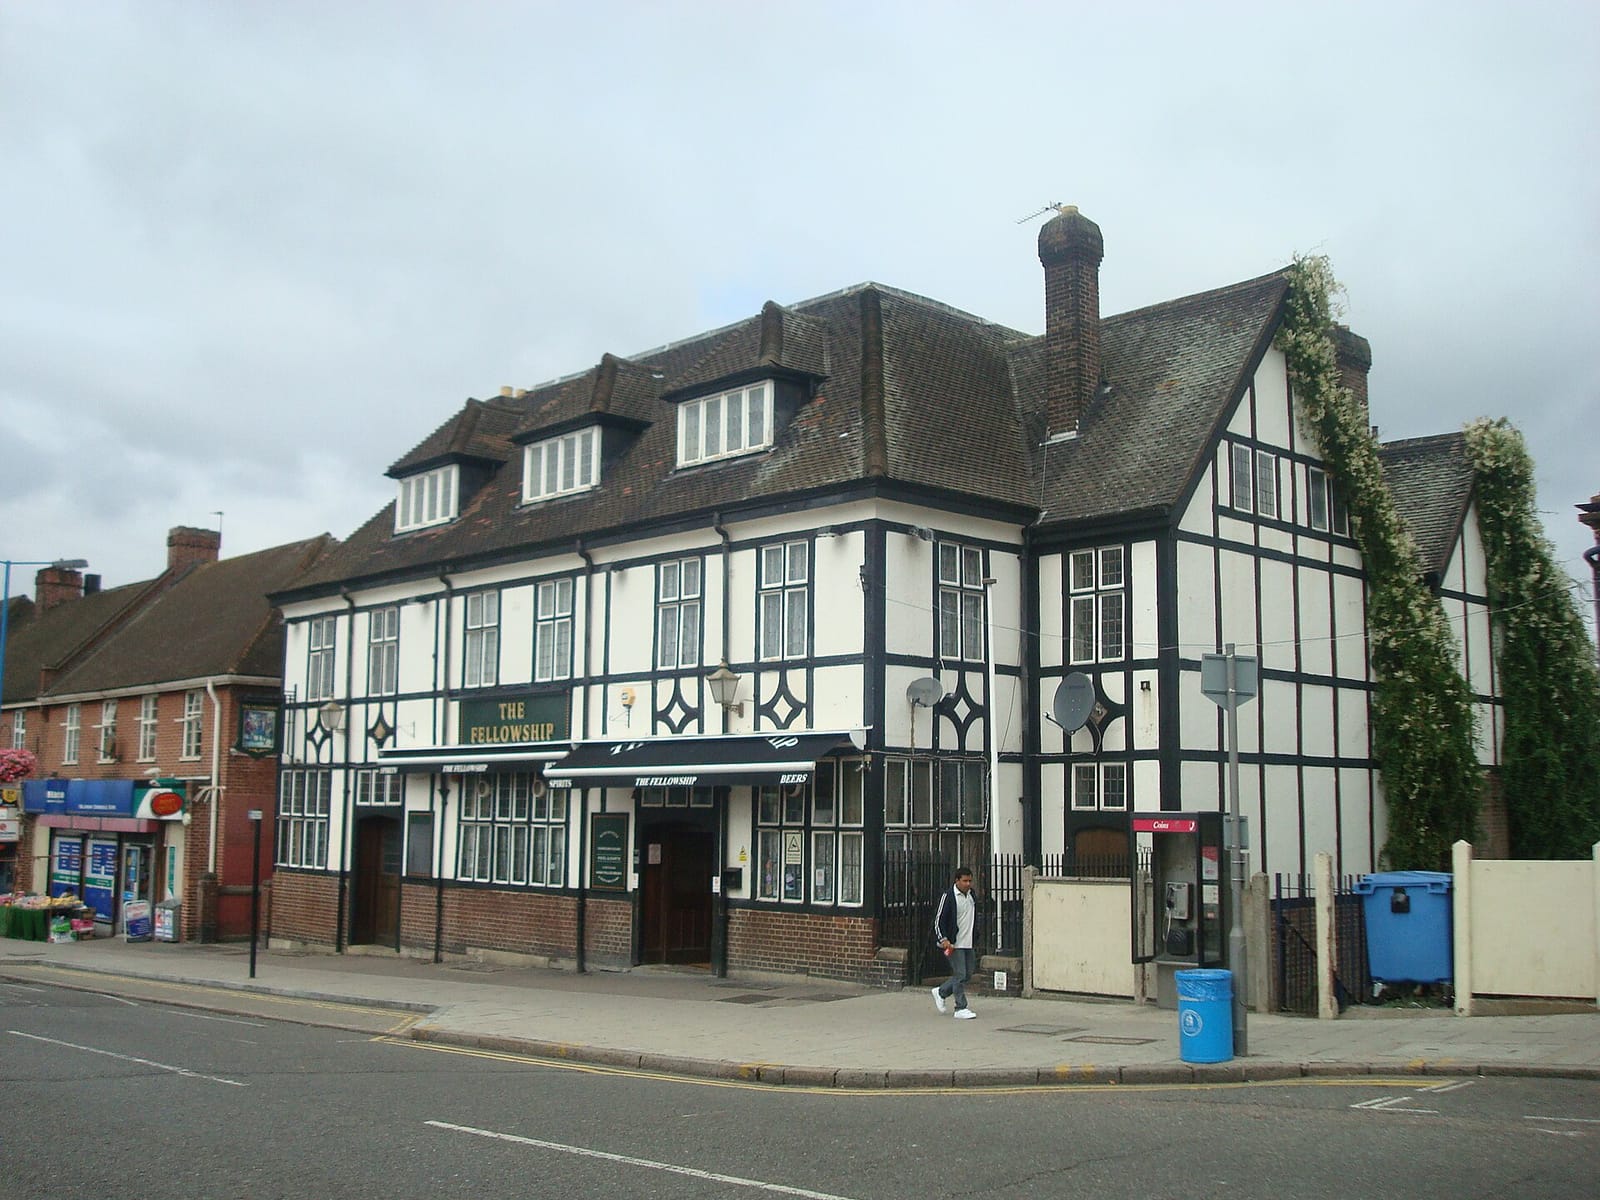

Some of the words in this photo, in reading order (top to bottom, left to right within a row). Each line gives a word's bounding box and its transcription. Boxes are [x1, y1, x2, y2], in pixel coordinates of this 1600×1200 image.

[498, 702, 525, 720] THE
[470, 722, 554, 744] FELLOWSHIP
[549, 779, 571, 788] SPIRITS
[635, 778, 650, 786] THE
[649, 776, 697, 786] FELLOWSHIP
[780, 773, 808, 784] BEERS
